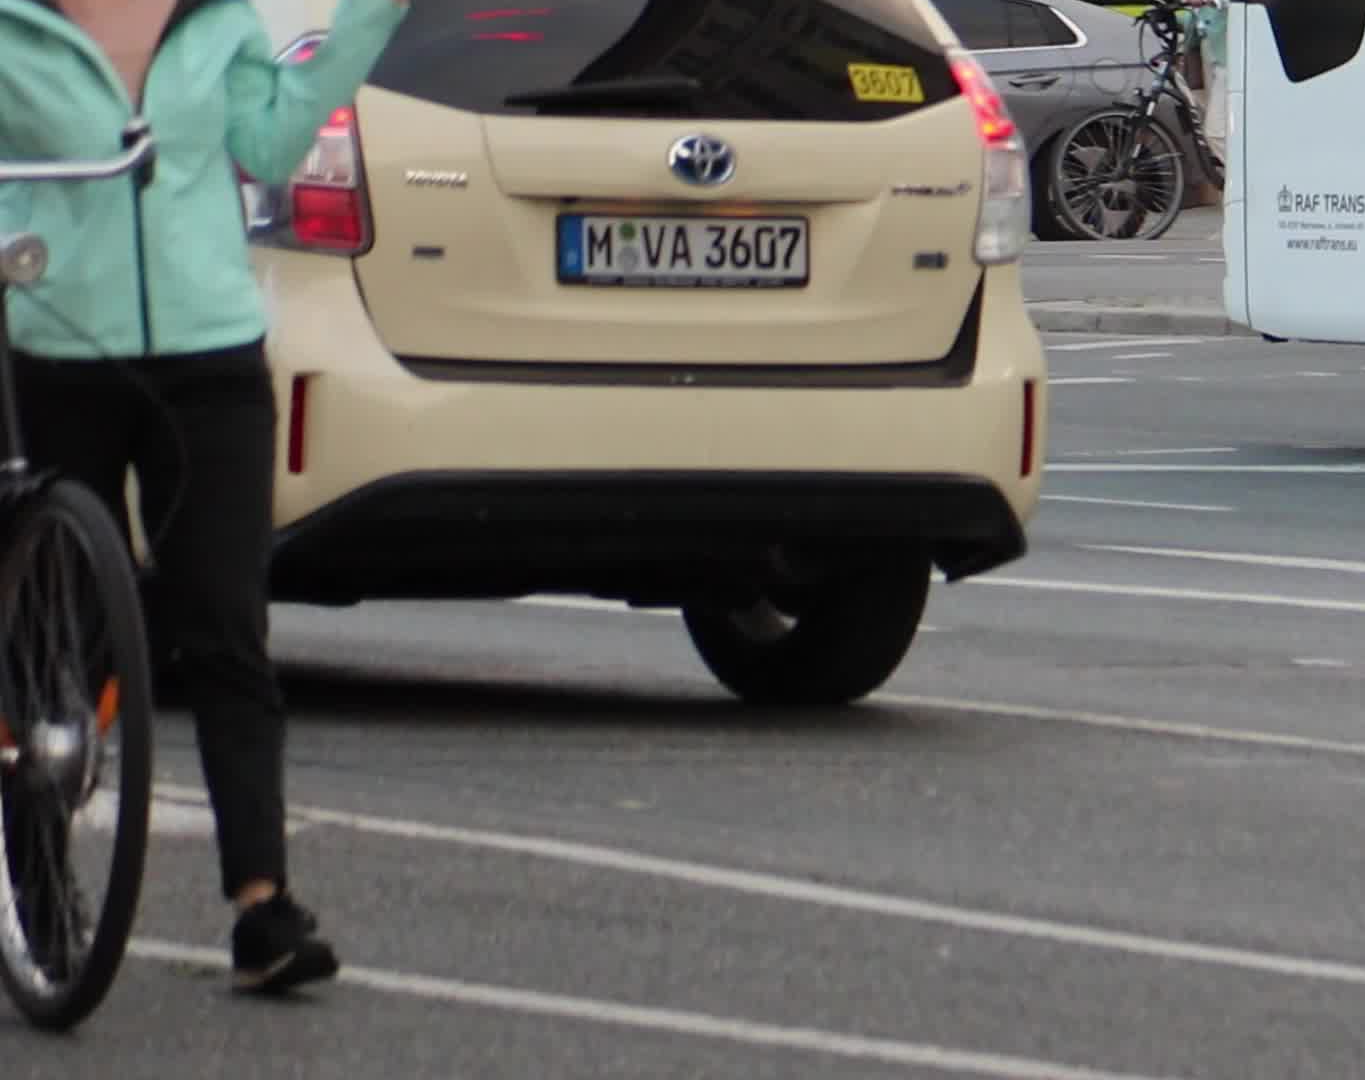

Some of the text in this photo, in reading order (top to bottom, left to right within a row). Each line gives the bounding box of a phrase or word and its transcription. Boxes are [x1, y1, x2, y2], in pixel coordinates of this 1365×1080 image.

[852, 69, 914, 97] 3607
[1295, 193, 1365, 214] RAF TRANS
[587, 224, 802, 270] M VA 3607
